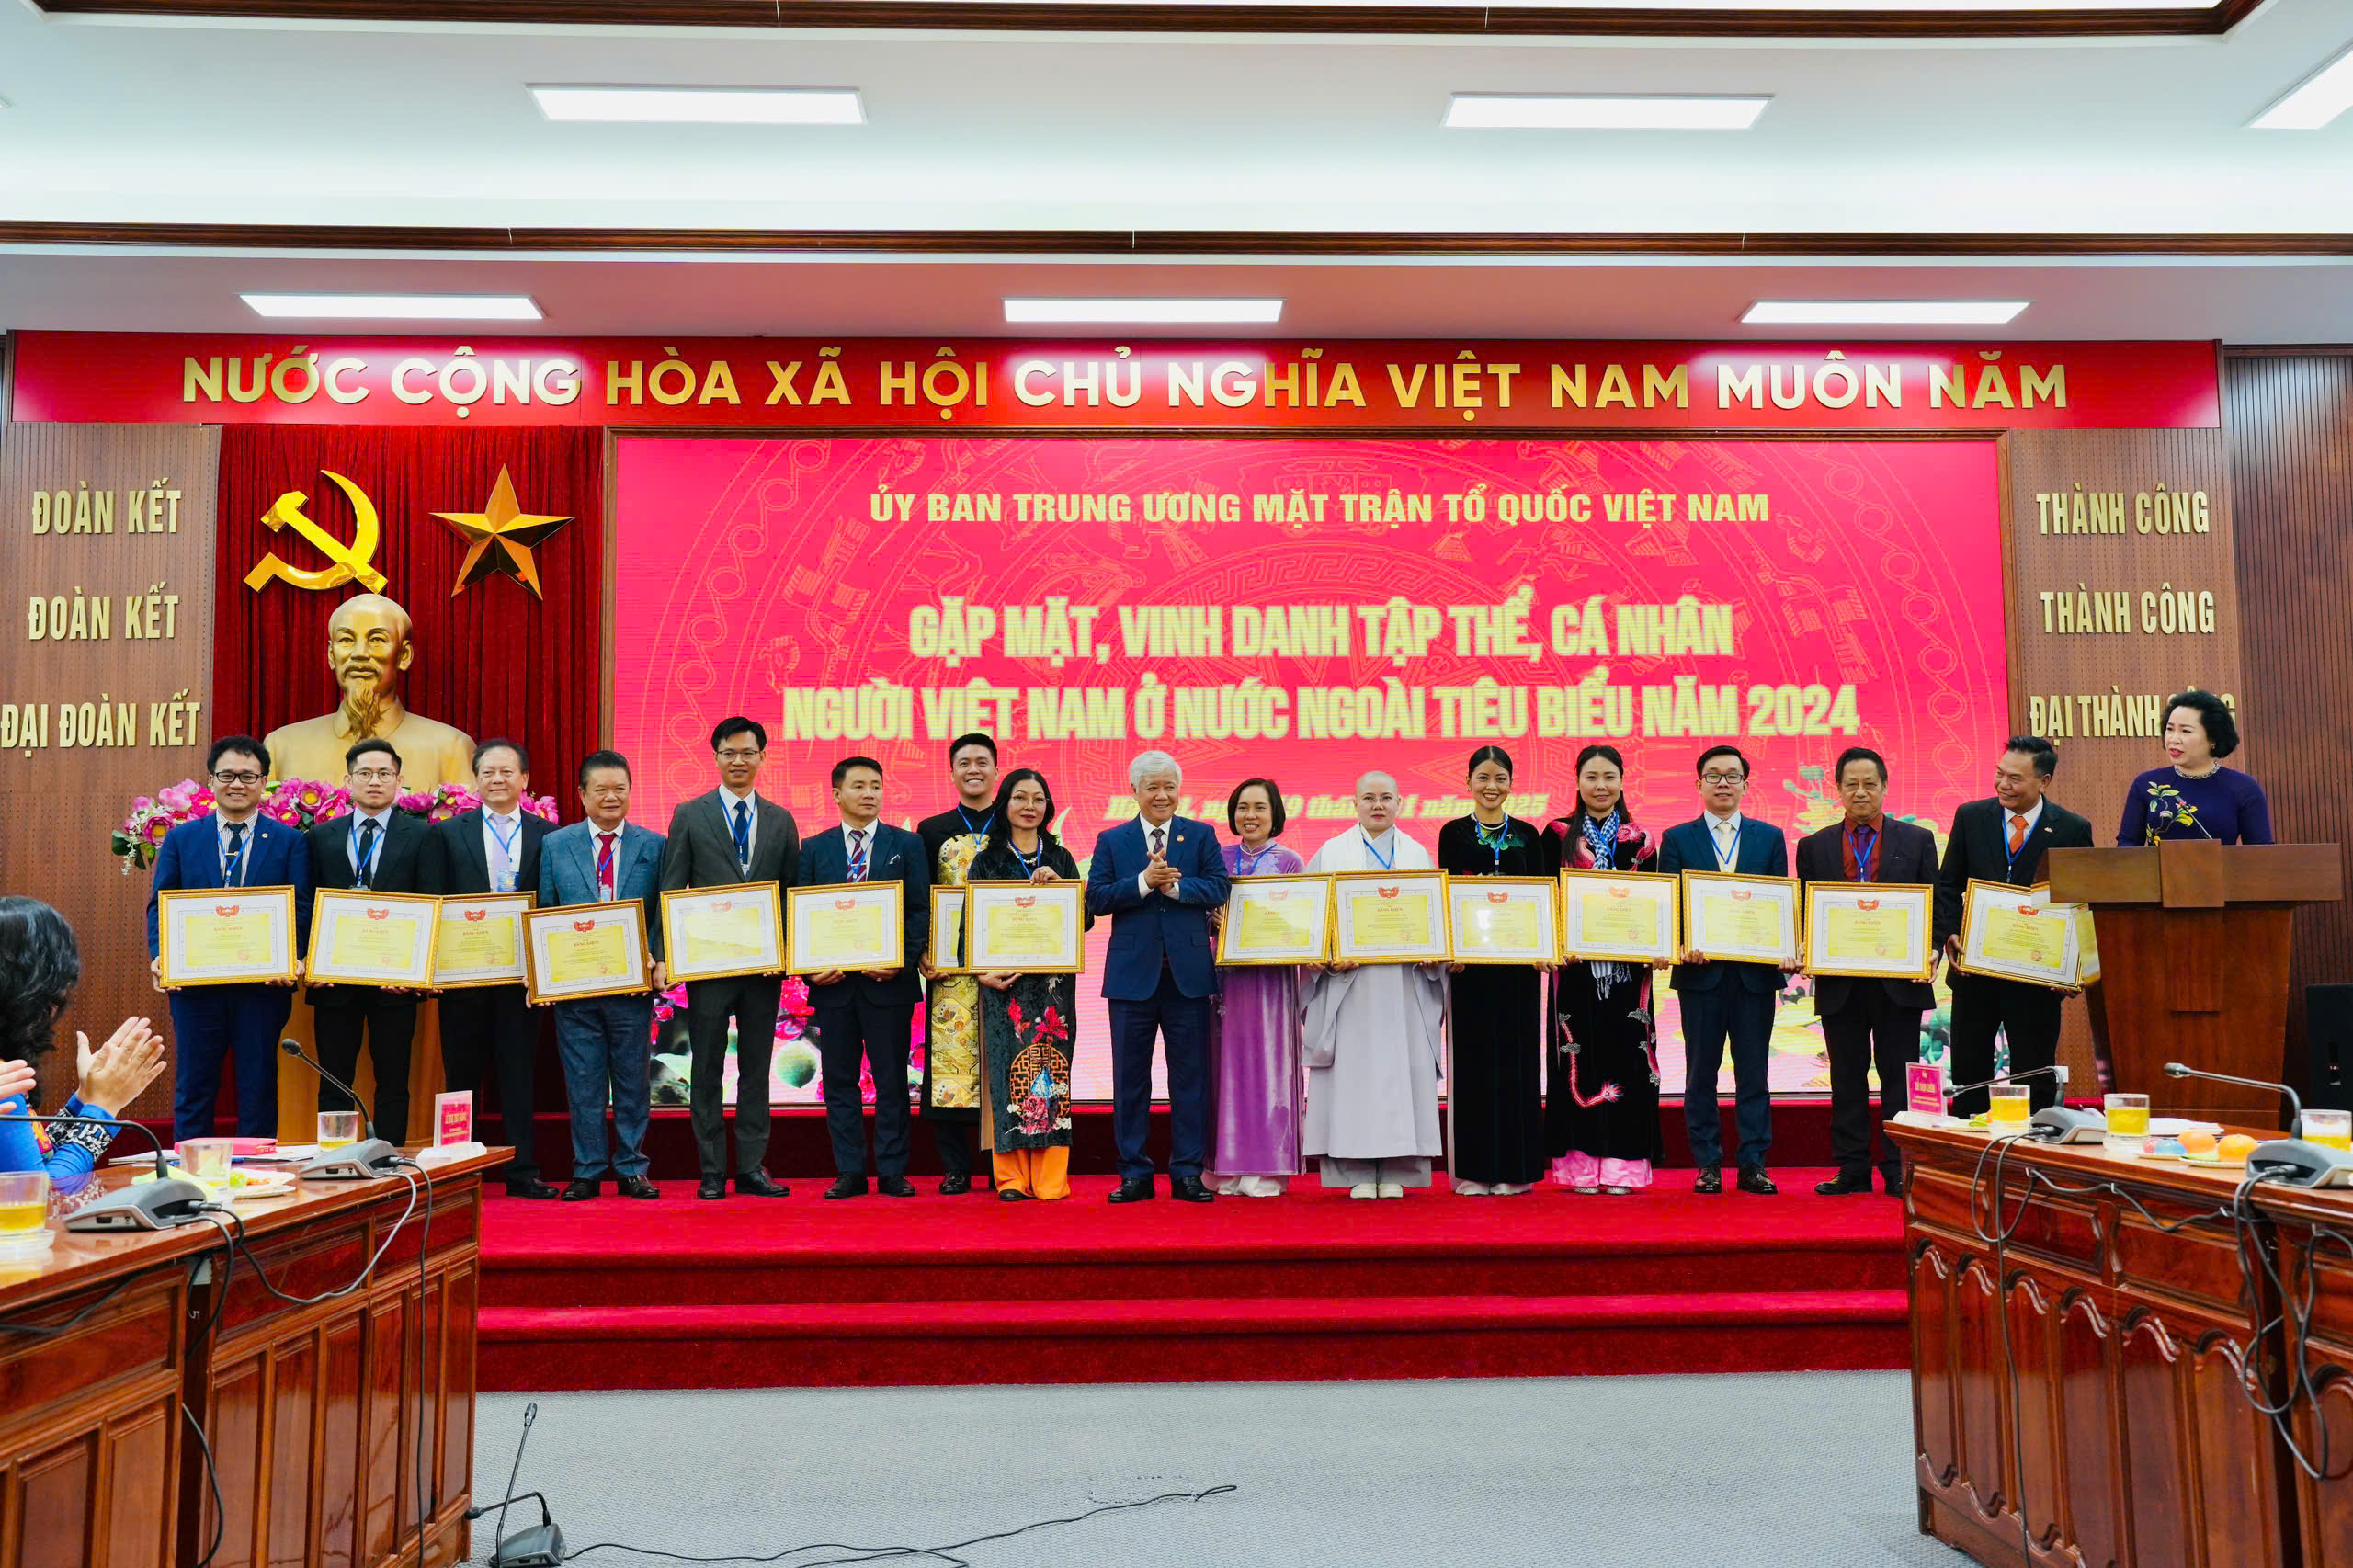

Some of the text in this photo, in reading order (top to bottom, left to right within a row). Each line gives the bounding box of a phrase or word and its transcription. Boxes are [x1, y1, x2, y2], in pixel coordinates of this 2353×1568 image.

[184, 345, 2067, 421] NƯỚC CỘNG HÒA XÃ HỘI CHỦ NGHĨA VIỆT NAM MUÔN NĂM
[32, 477, 181, 534] ĐOÀN KẾT
[870, 483, 1769, 528] ỦY BAN TRUNG ƯƠNG MẶT TRẬN TỔ QUỐC VIỆT NAM
[2036, 483, 2209, 535] THÀNH CÔNG
[28, 581, 179, 641] ĐOÀN KẾT
[909, 585, 1733, 667] GẶP MẶT, VINH DANH TẬP THỂ, CÁ NHÂN
[2040, 583, 2214, 634] THÀNH CÔNG
[0, 688, 201, 758] ĐẠI ĐOÀN KẾT
[782, 677, 914, 740] NGƯỜI
[1027, 687, 1126, 740] NAM
[1134, 671, 1168, 739] Ở
[1174, 676, 1289, 739] NƯỚC
[1297, 676, 1426, 739] NGOÀI
[1433, 676, 1529, 738] TIÊU
[1537, 665, 1633, 737] BIỂU
[1641, 676, 1739, 736] NĂM
[1747, 684, 1861, 736] 2024
[2030, 694, 2074, 746] ĐẠI
[2077, 685, 2161, 738] THÀNH
[1502, 793, 1551, 818] 025
